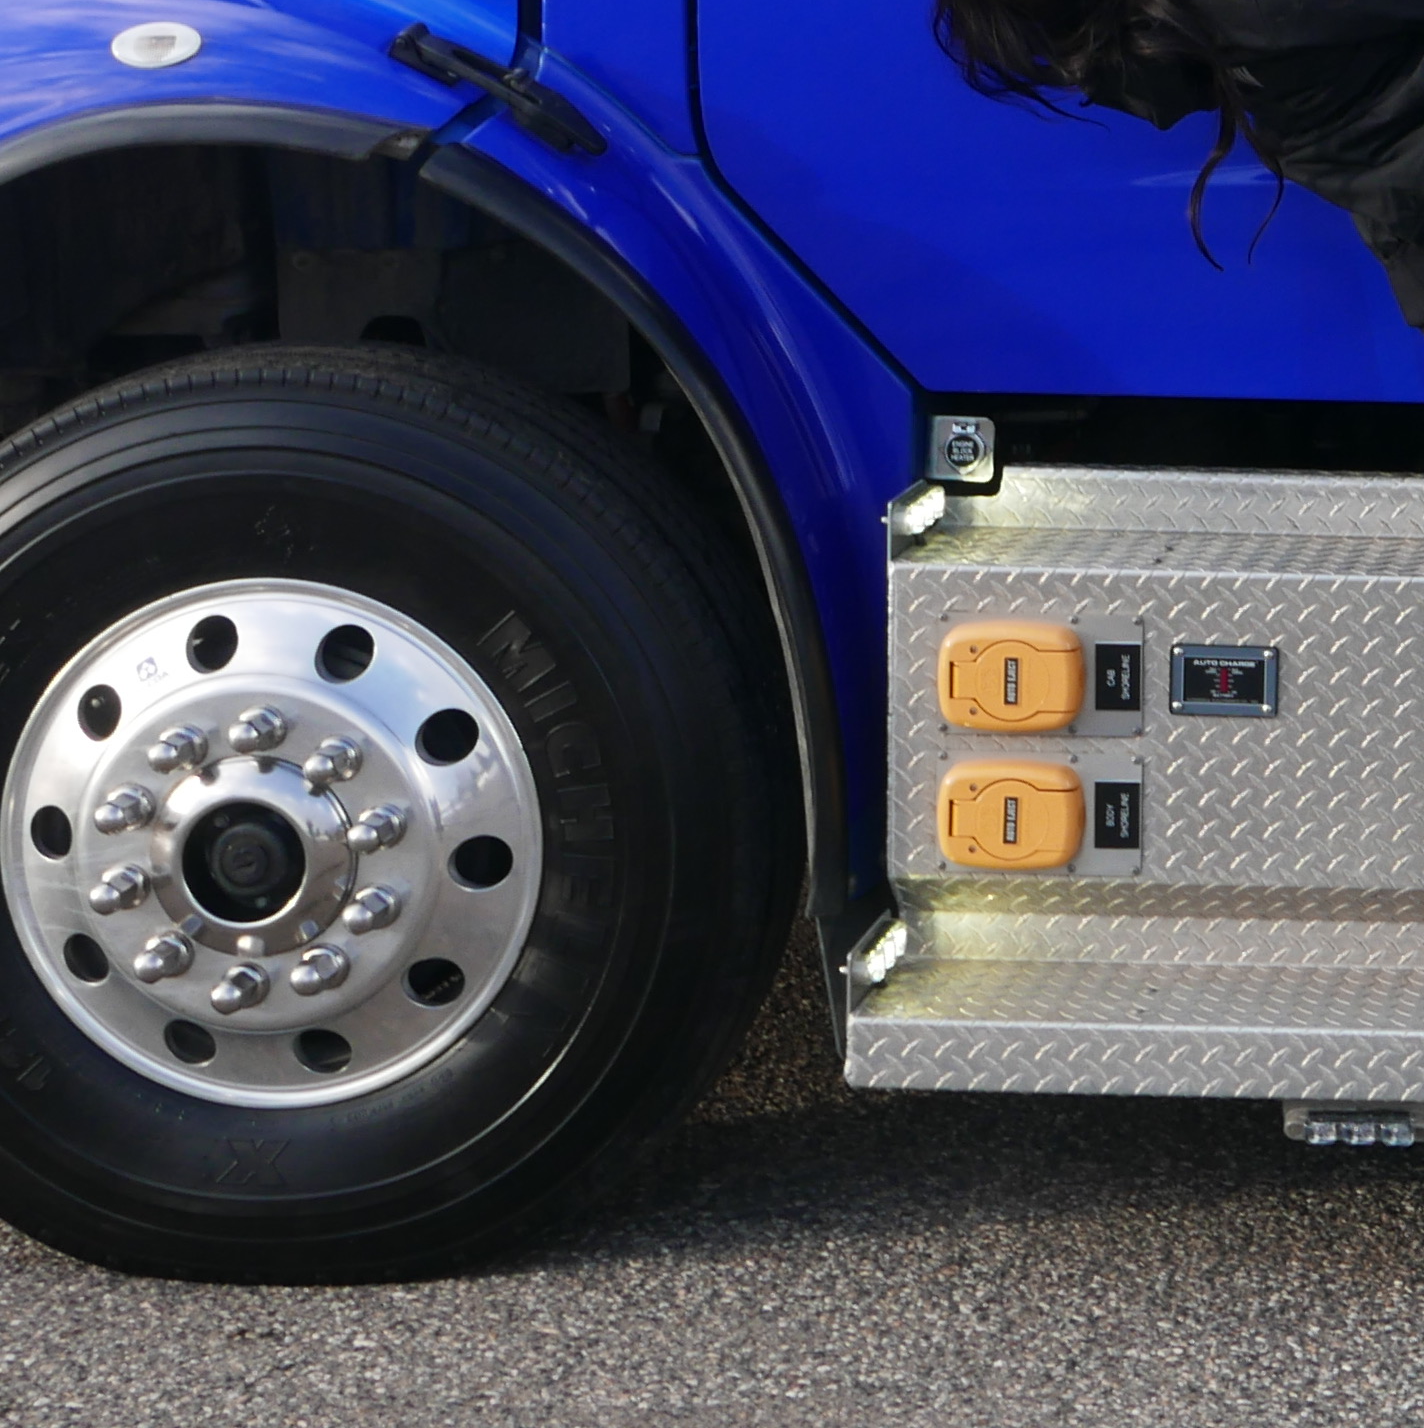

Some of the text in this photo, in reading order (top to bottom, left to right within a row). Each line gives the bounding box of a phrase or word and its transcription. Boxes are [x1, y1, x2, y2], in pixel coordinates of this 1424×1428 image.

[1106, 669, 1116, 688] CAB
[1121, 653, 1131, 701] SHORELINE
[1120, 792, 1130, 839] SHORELINE
